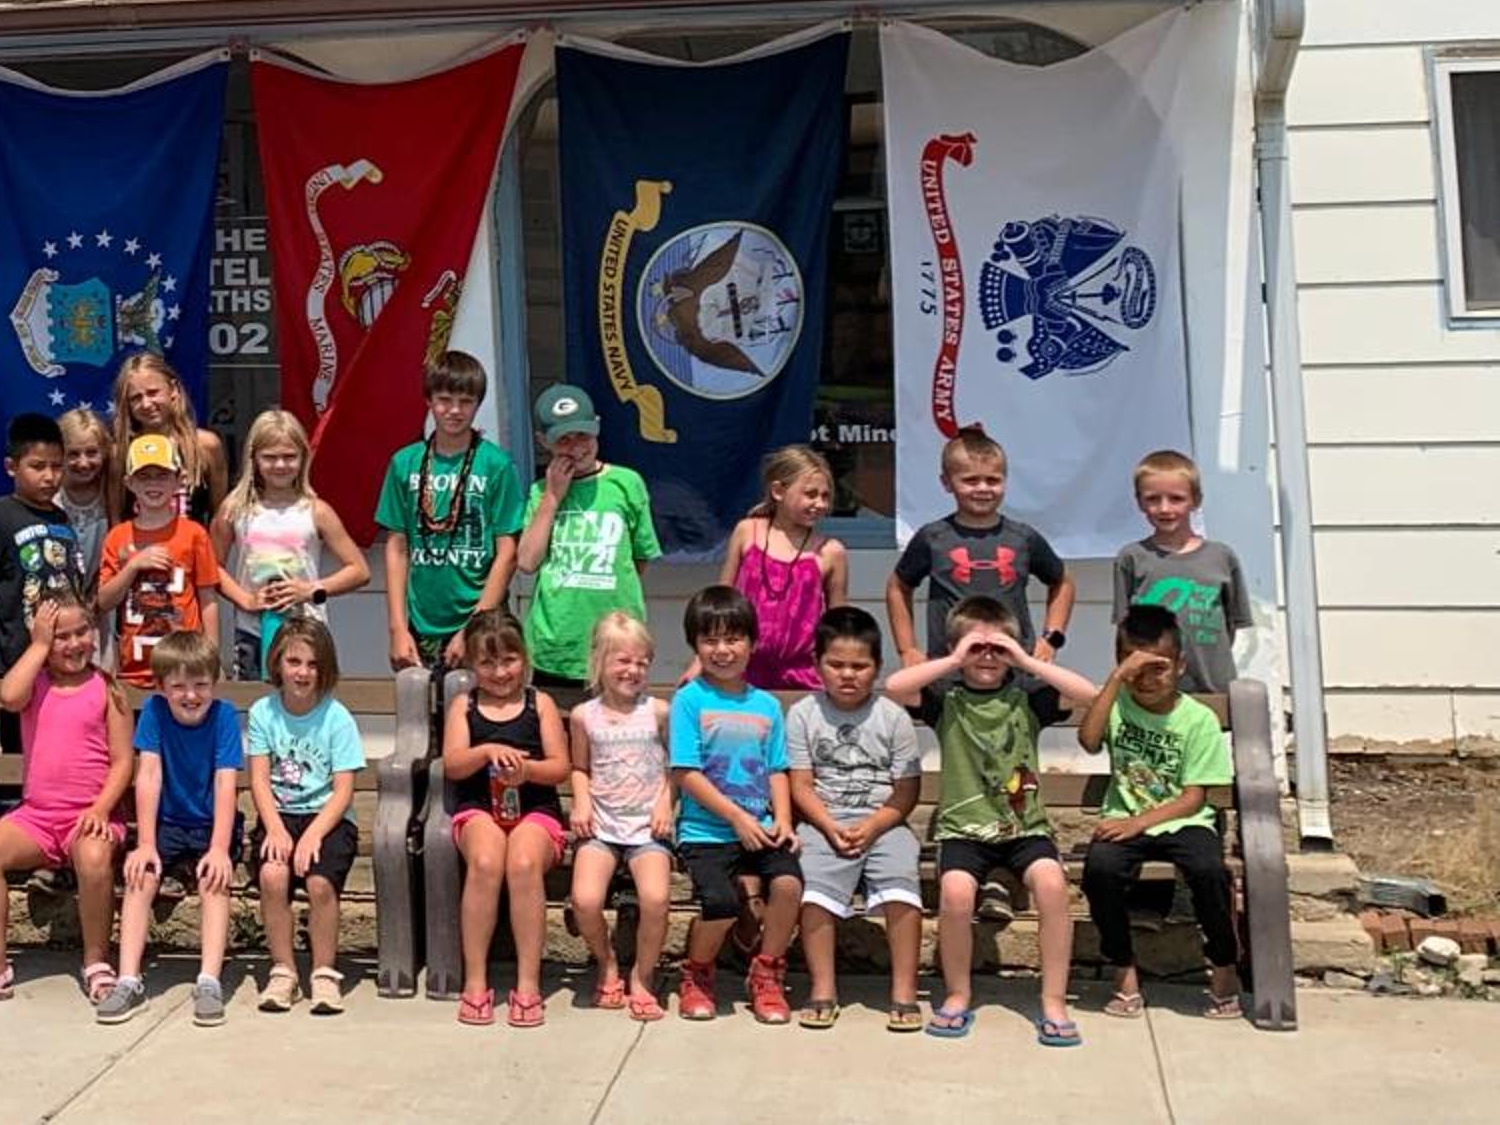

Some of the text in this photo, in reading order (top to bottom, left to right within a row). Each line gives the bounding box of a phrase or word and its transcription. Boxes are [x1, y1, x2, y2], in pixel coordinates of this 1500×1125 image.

[208, 288, 272, 313] THS
[603, 219, 634, 392] UNITED STATES NAVY
[919, 261, 937, 315] 1775
[922, 160, 961, 421] UNITED STATES ARMY
[208, 322, 269, 355] 02
